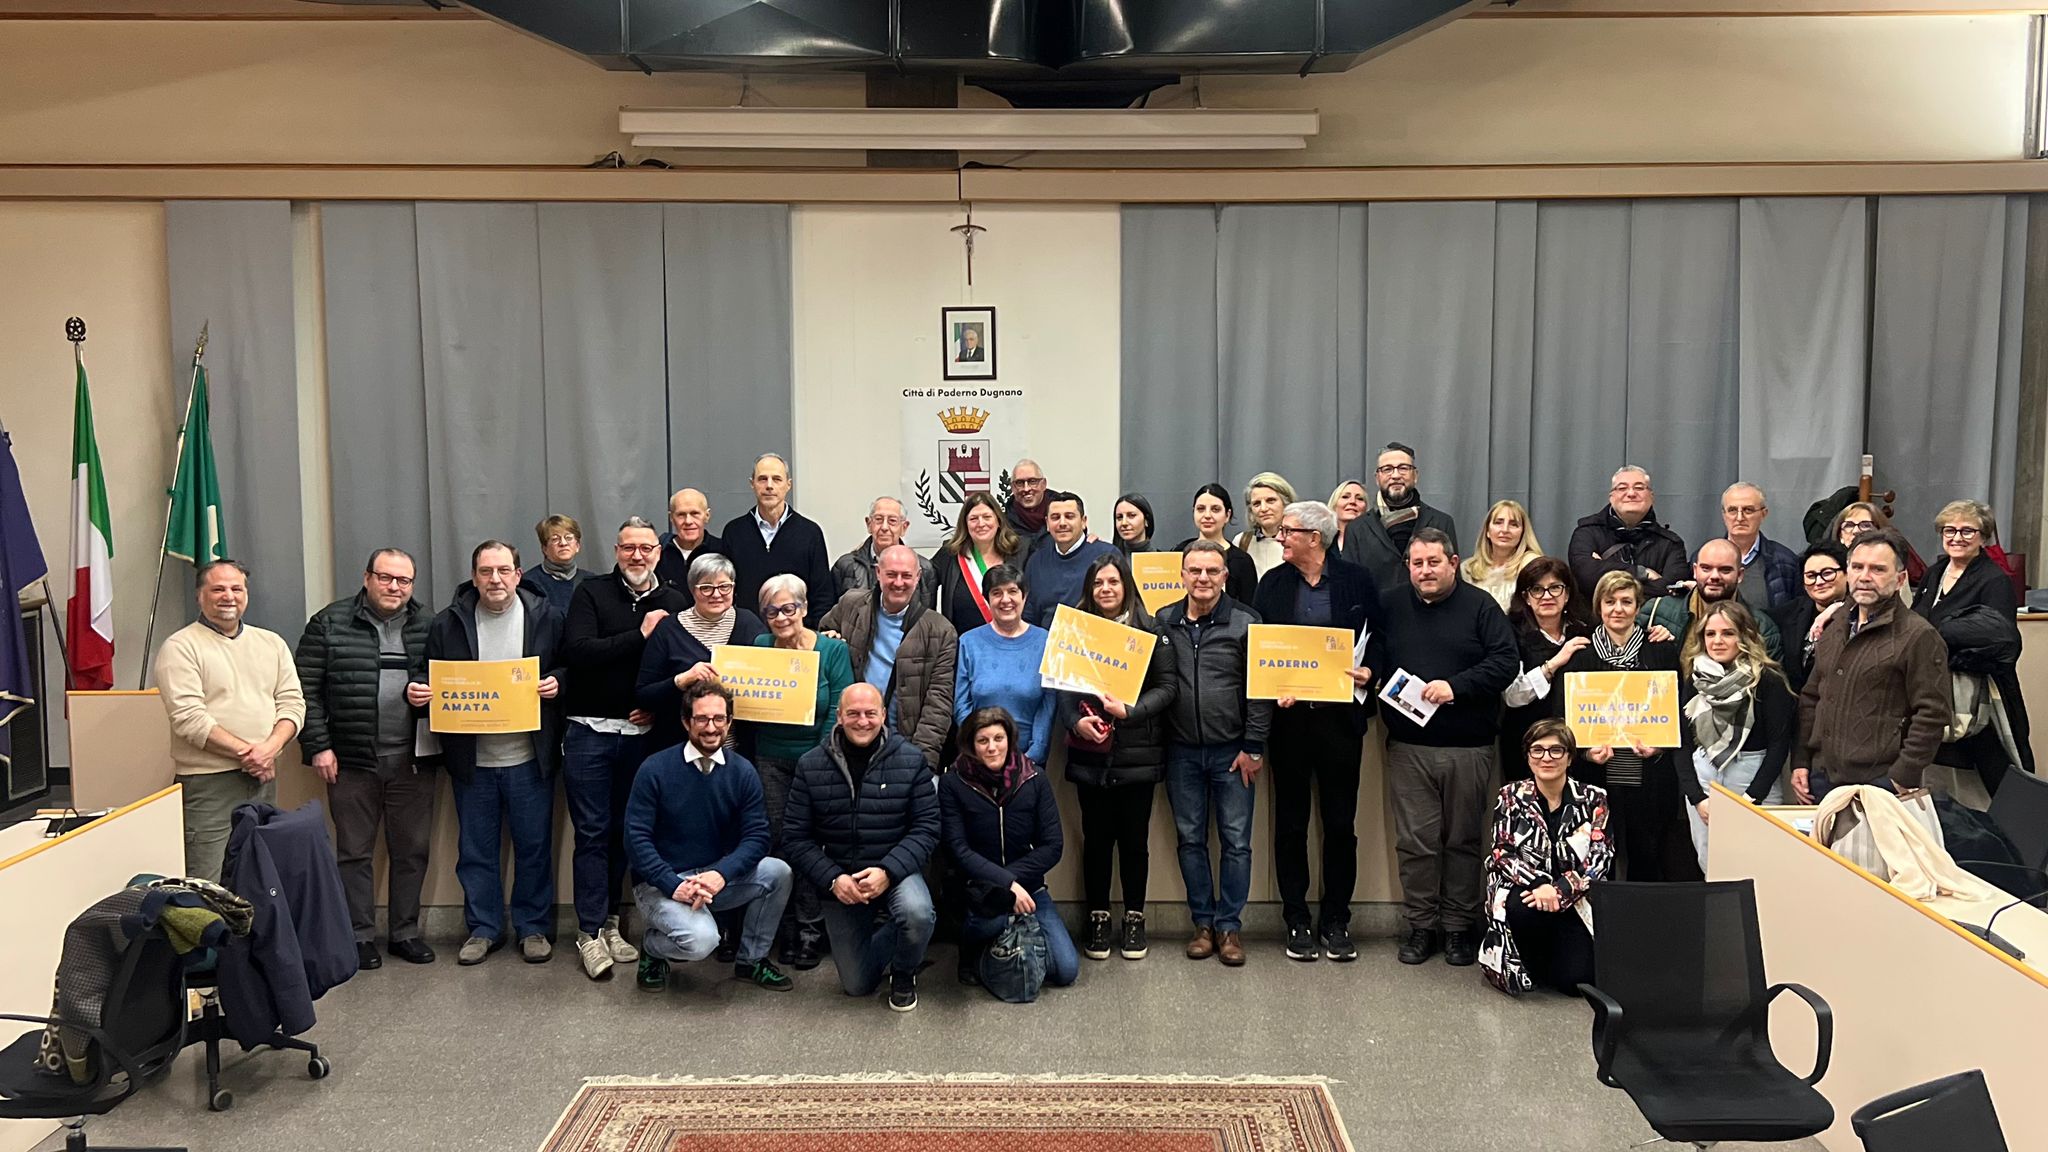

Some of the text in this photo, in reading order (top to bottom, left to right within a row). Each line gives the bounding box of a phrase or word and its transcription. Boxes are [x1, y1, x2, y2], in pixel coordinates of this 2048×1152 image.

[903, 388, 1023, 399] Città di Paderno Dugnano
[1143, 582, 1186, 590] DUGNA
[1259, 659, 1319, 669] PADERNO
[721, 675, 798, 688] PALAZZOLO
[441, 691, 500, 699] CASSINA
[442, 703, 491, 711] AMATA
[1578, 703, 1650, 711] VILAGIO
[1579, 715, 1669, 723] AMBOIANO
